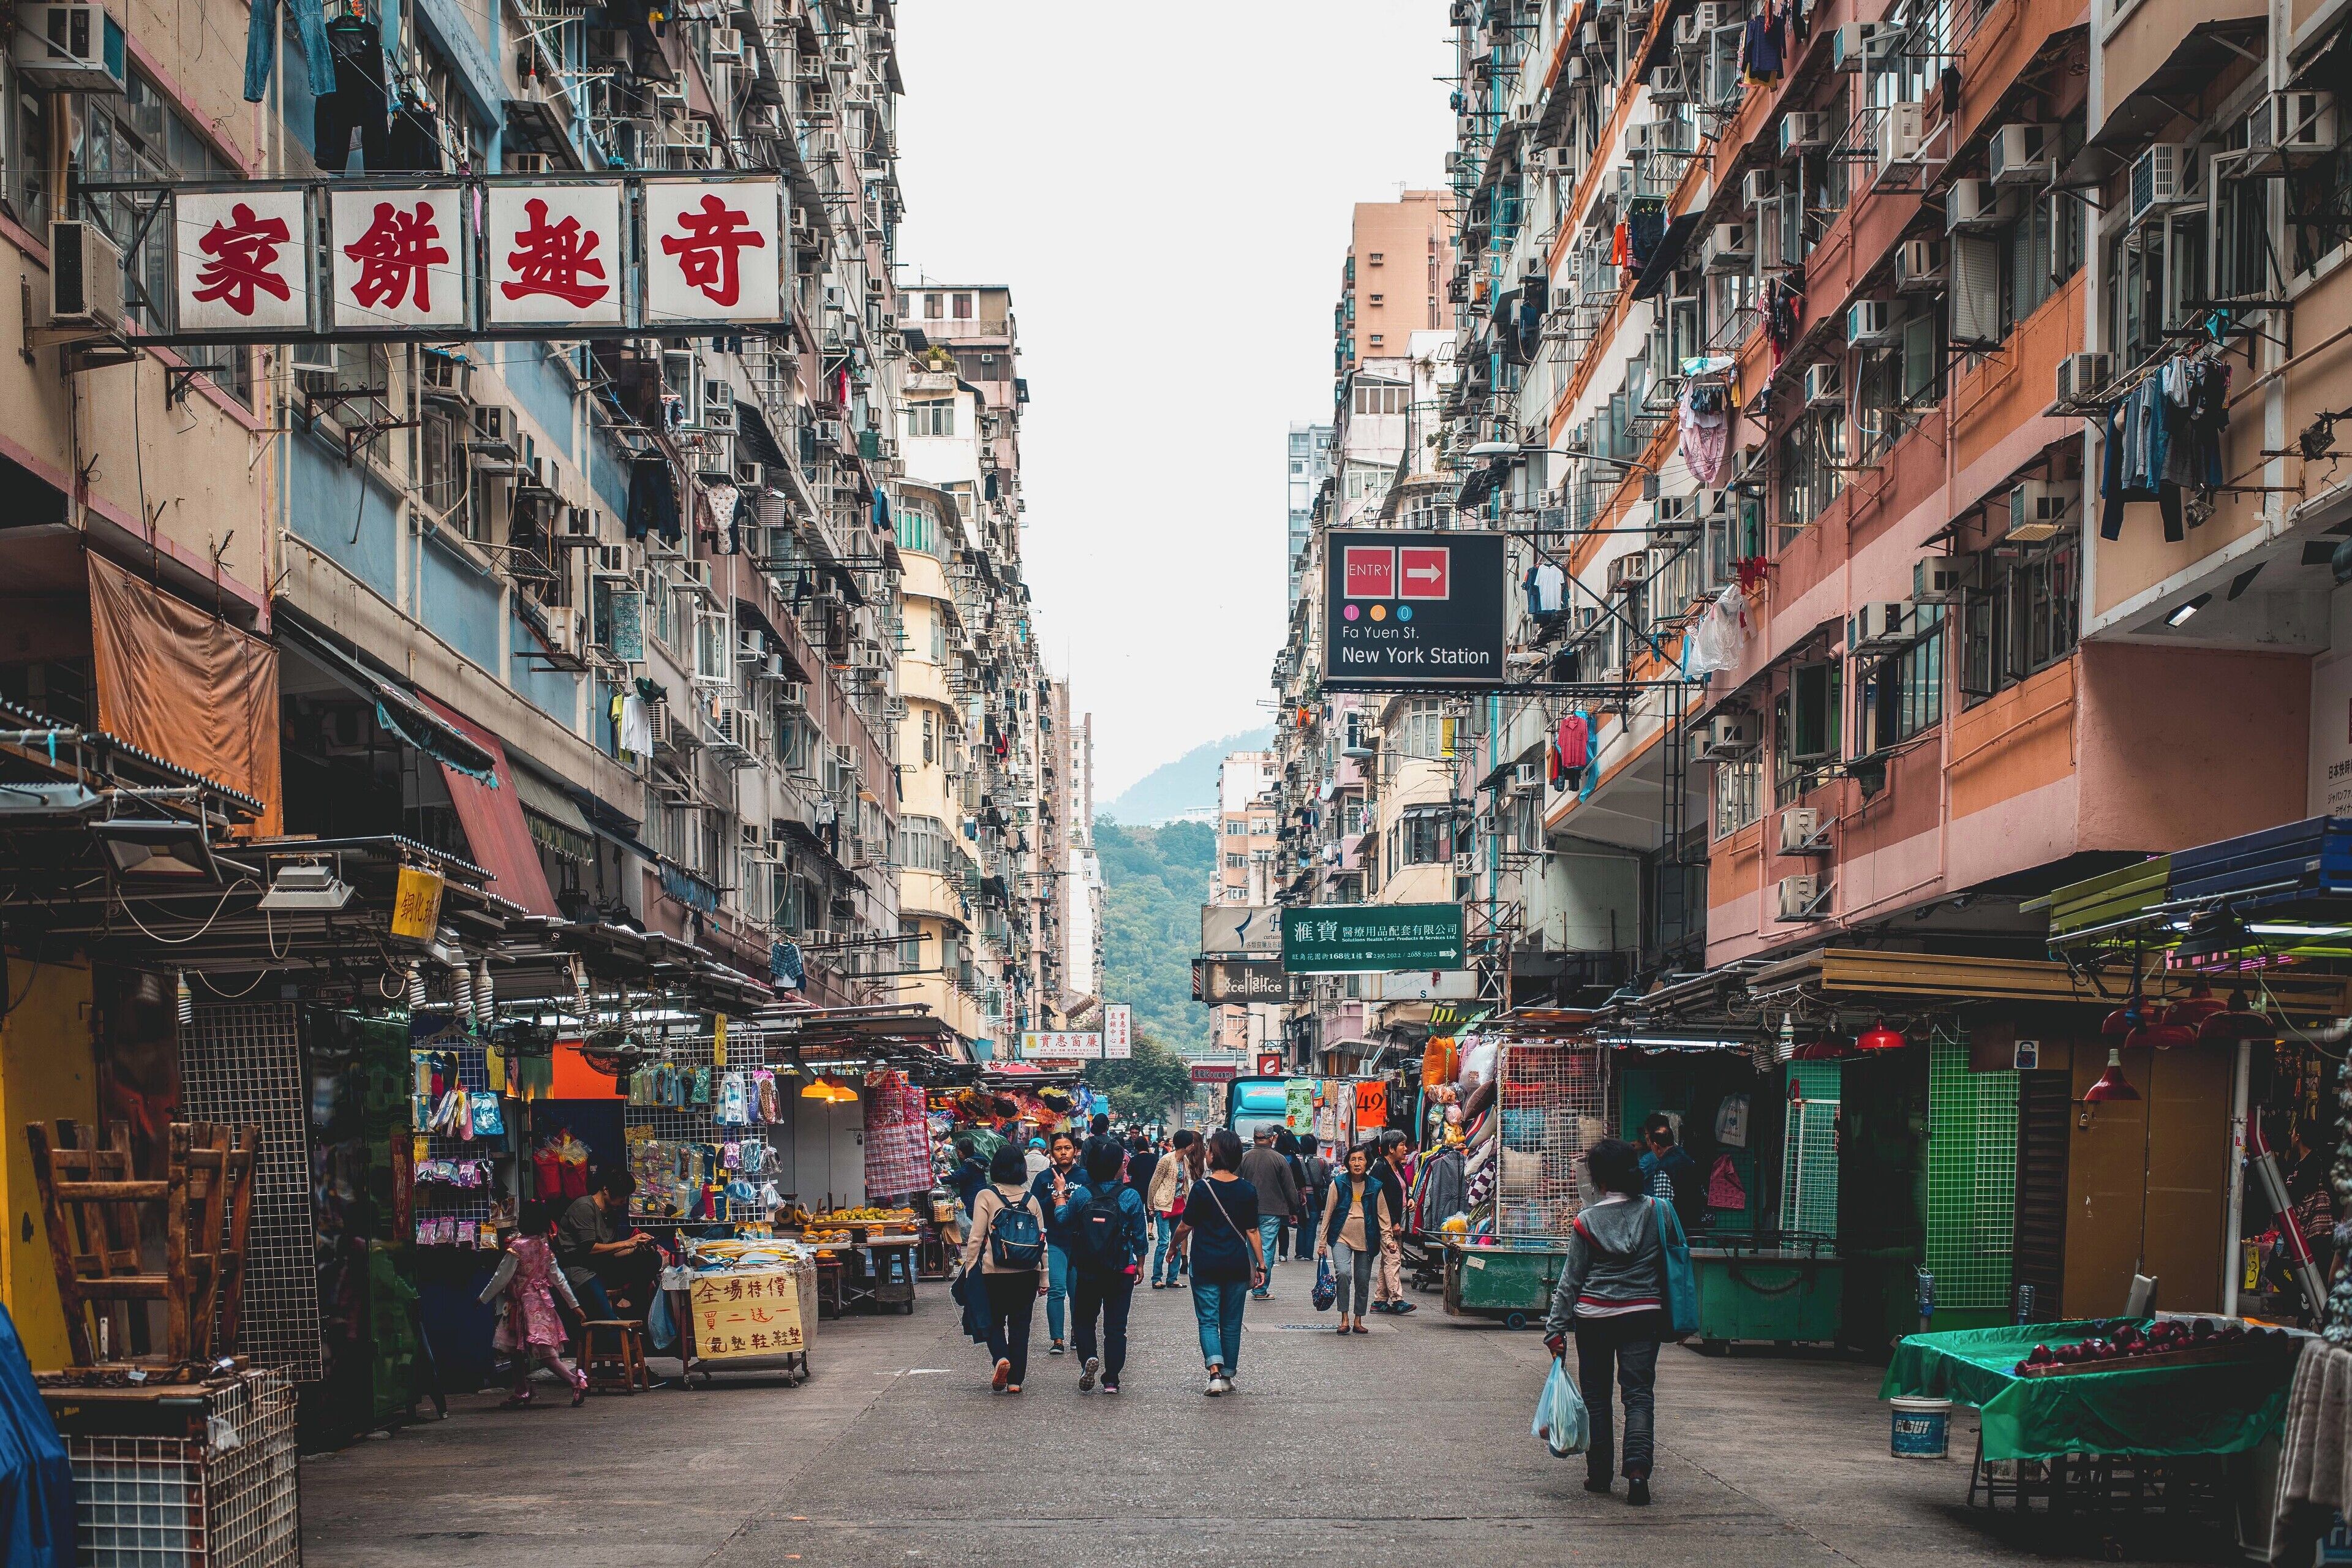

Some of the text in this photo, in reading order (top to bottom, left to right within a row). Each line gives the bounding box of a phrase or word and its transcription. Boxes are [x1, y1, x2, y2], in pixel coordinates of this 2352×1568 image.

[1349, 564, 1390, 576] ENTRY
[1343, 626, 1419, 639] Fa Yuen St.
[1343, 647, 1489, 664] New York Station
[2328, 790, 2352, 804] ジャパンファ
[1343, 924, 1457, 937] 醫療用品配套有限公司
[1039, 1033, 1099, 1047] 實惠窗簾
[1357, 1092, 1384, 1112] 49
[695, 1276, 786, 1303] 全場特價
[704, 1308, 791, 1330] 買二送一
